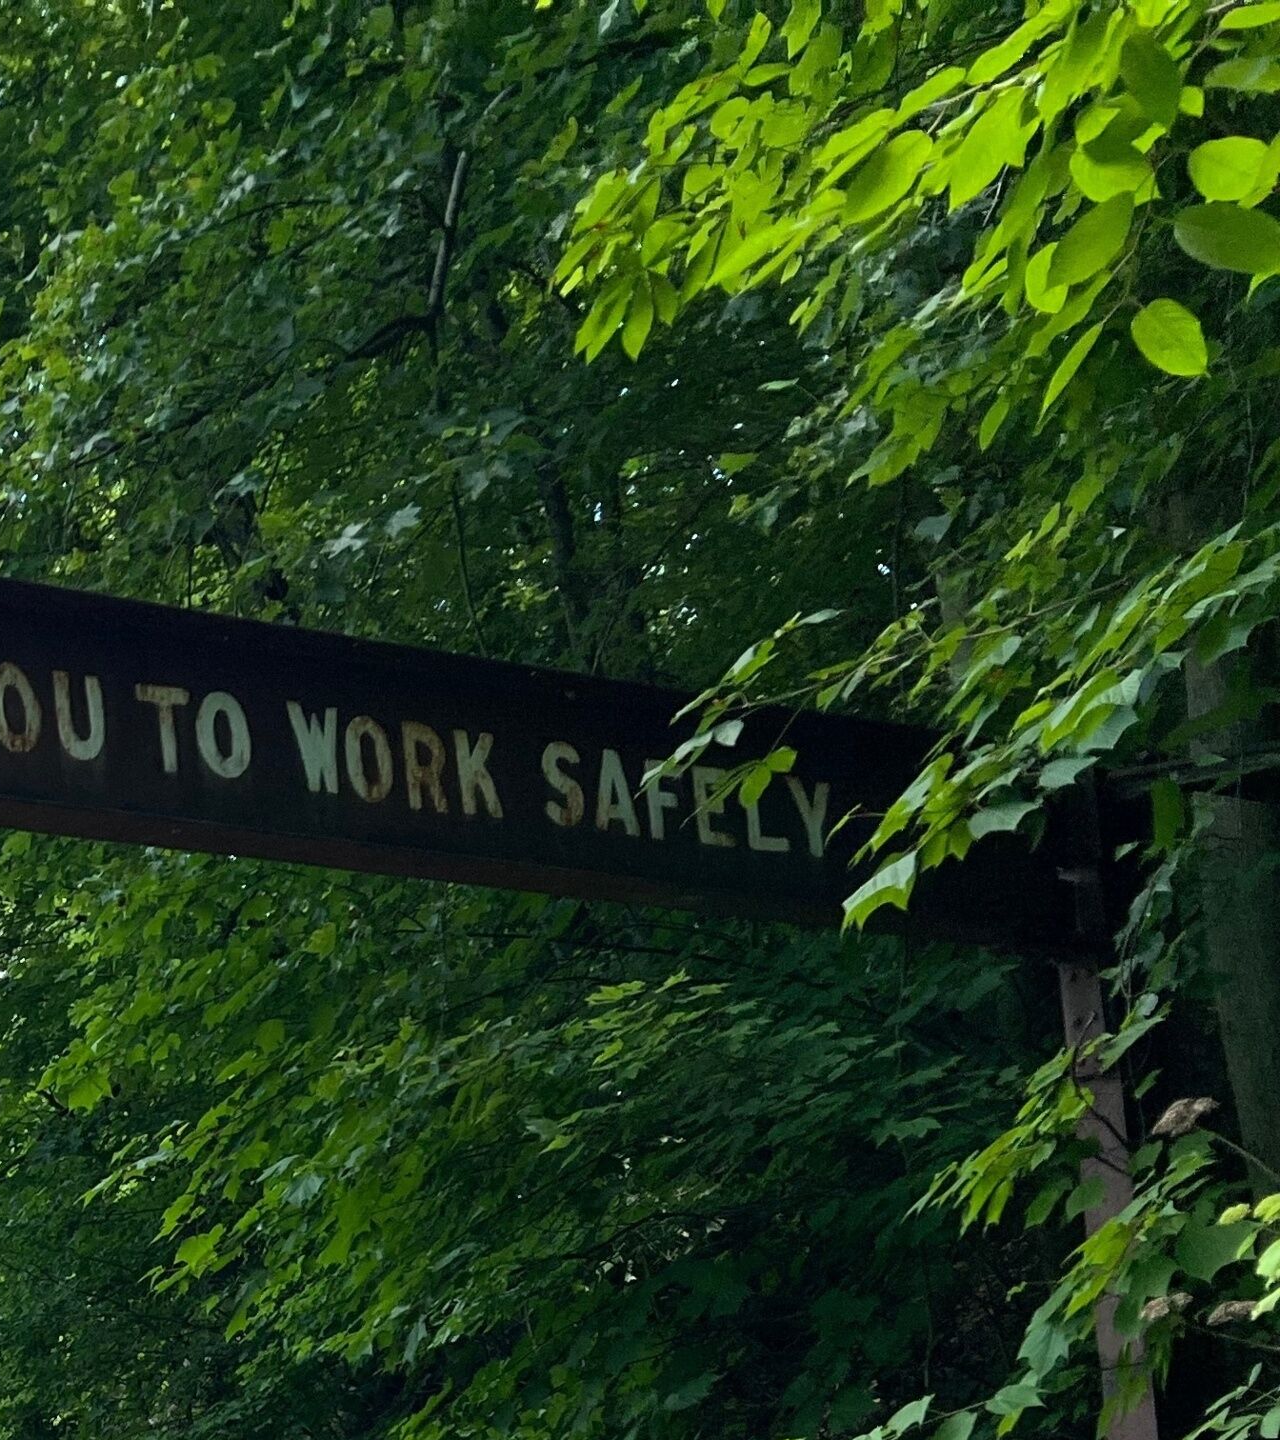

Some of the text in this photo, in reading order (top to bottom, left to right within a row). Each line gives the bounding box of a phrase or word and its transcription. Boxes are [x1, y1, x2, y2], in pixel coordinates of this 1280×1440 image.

[134, 683, 251, 779] TO
[285, 700, 504, 819] WORK
[541, 740, 831, 858] SAFELY
